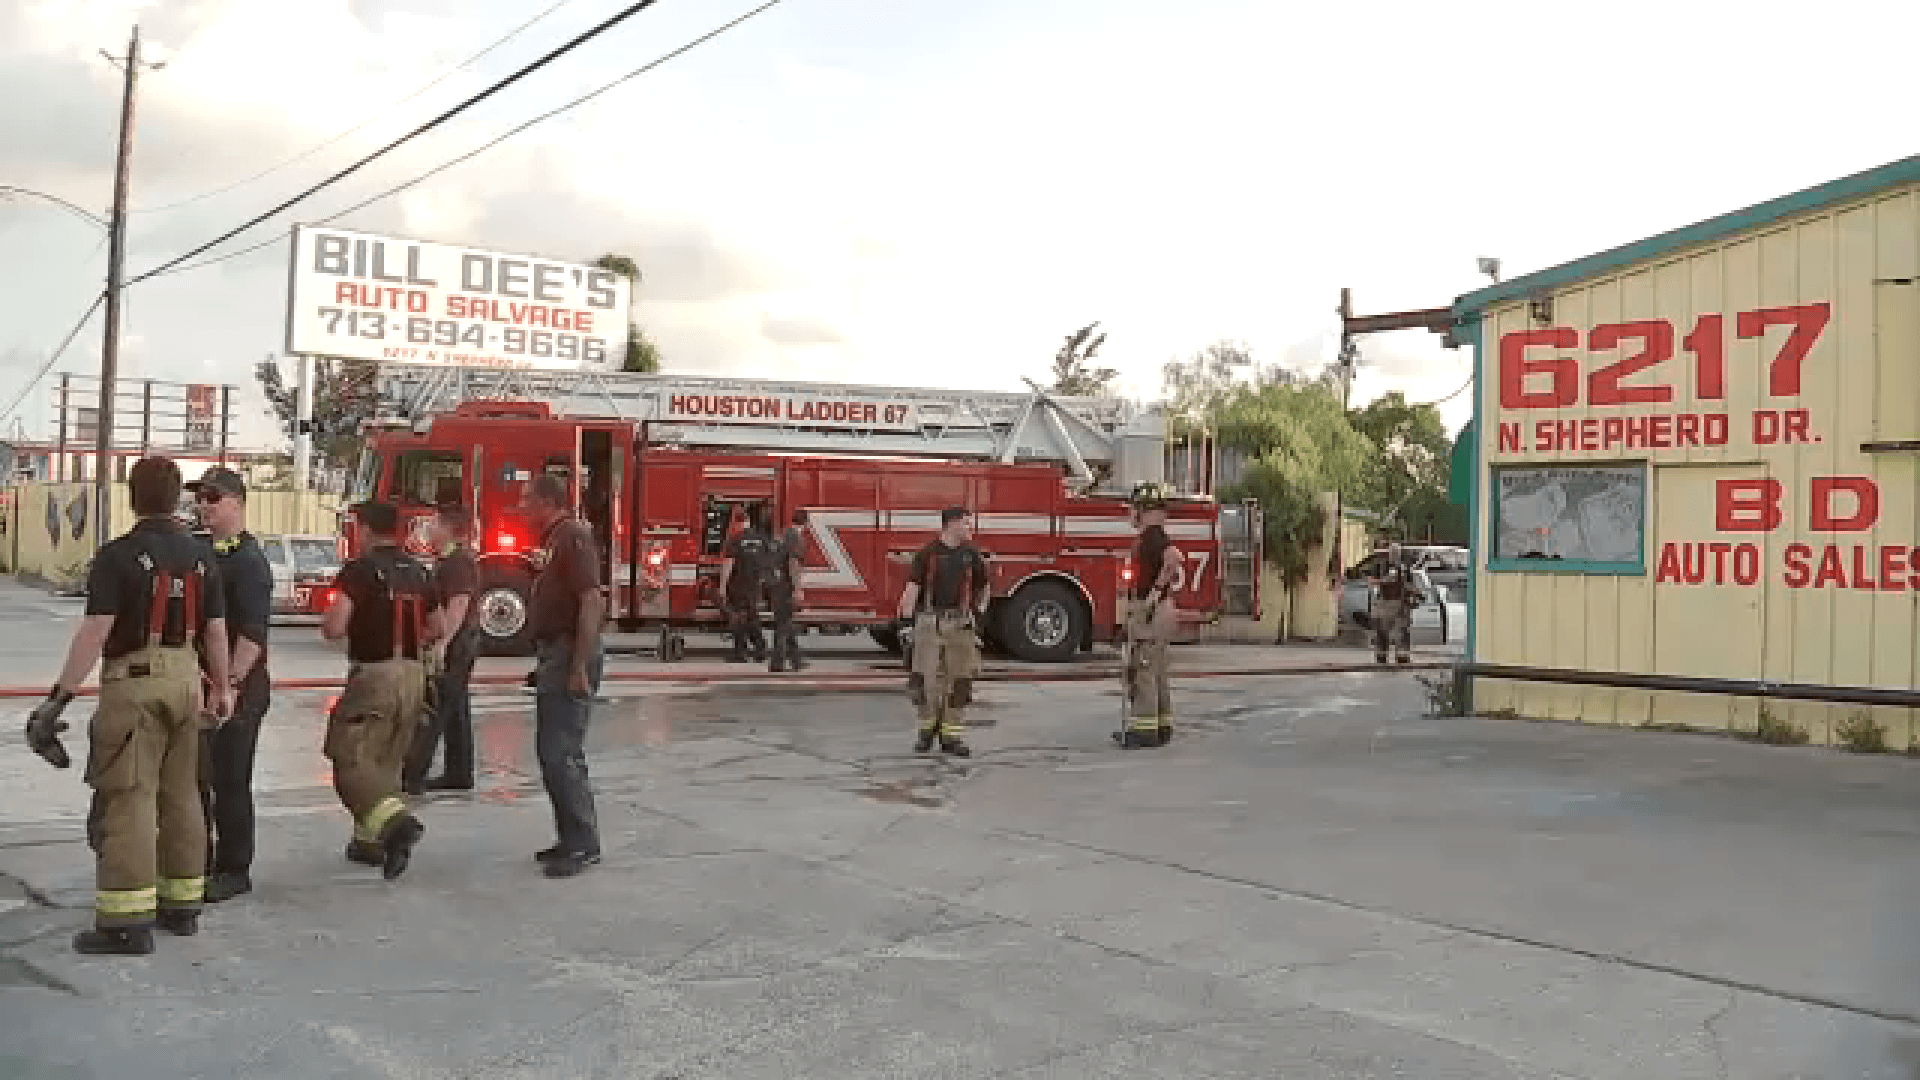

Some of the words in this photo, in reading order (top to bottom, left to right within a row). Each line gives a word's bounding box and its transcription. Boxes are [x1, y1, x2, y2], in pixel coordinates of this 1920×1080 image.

[314, 234, 438, 287] BILL
[461, 254, 616, 309] DEE'S
[336, 281, 428, 313] AUTO
[447, 294, 594, 332] SALVAGE
[1499, 302, 1831, 409] 6217
[670, 395, 781, 419] HOUSTON
[786, 399, 877, 423] LADDER
[884, 404, 909, 424] 67
[1499, 421, 1528, 454] N.
[1535, 413, 1729, 451] SHEPHERD
[1752, 408, 1822, 445] DR.
[1715, 477, 1784, 532] B
[1810, 476, 1880, 532] D
[1655, 542, 1760, 586] AUTO
